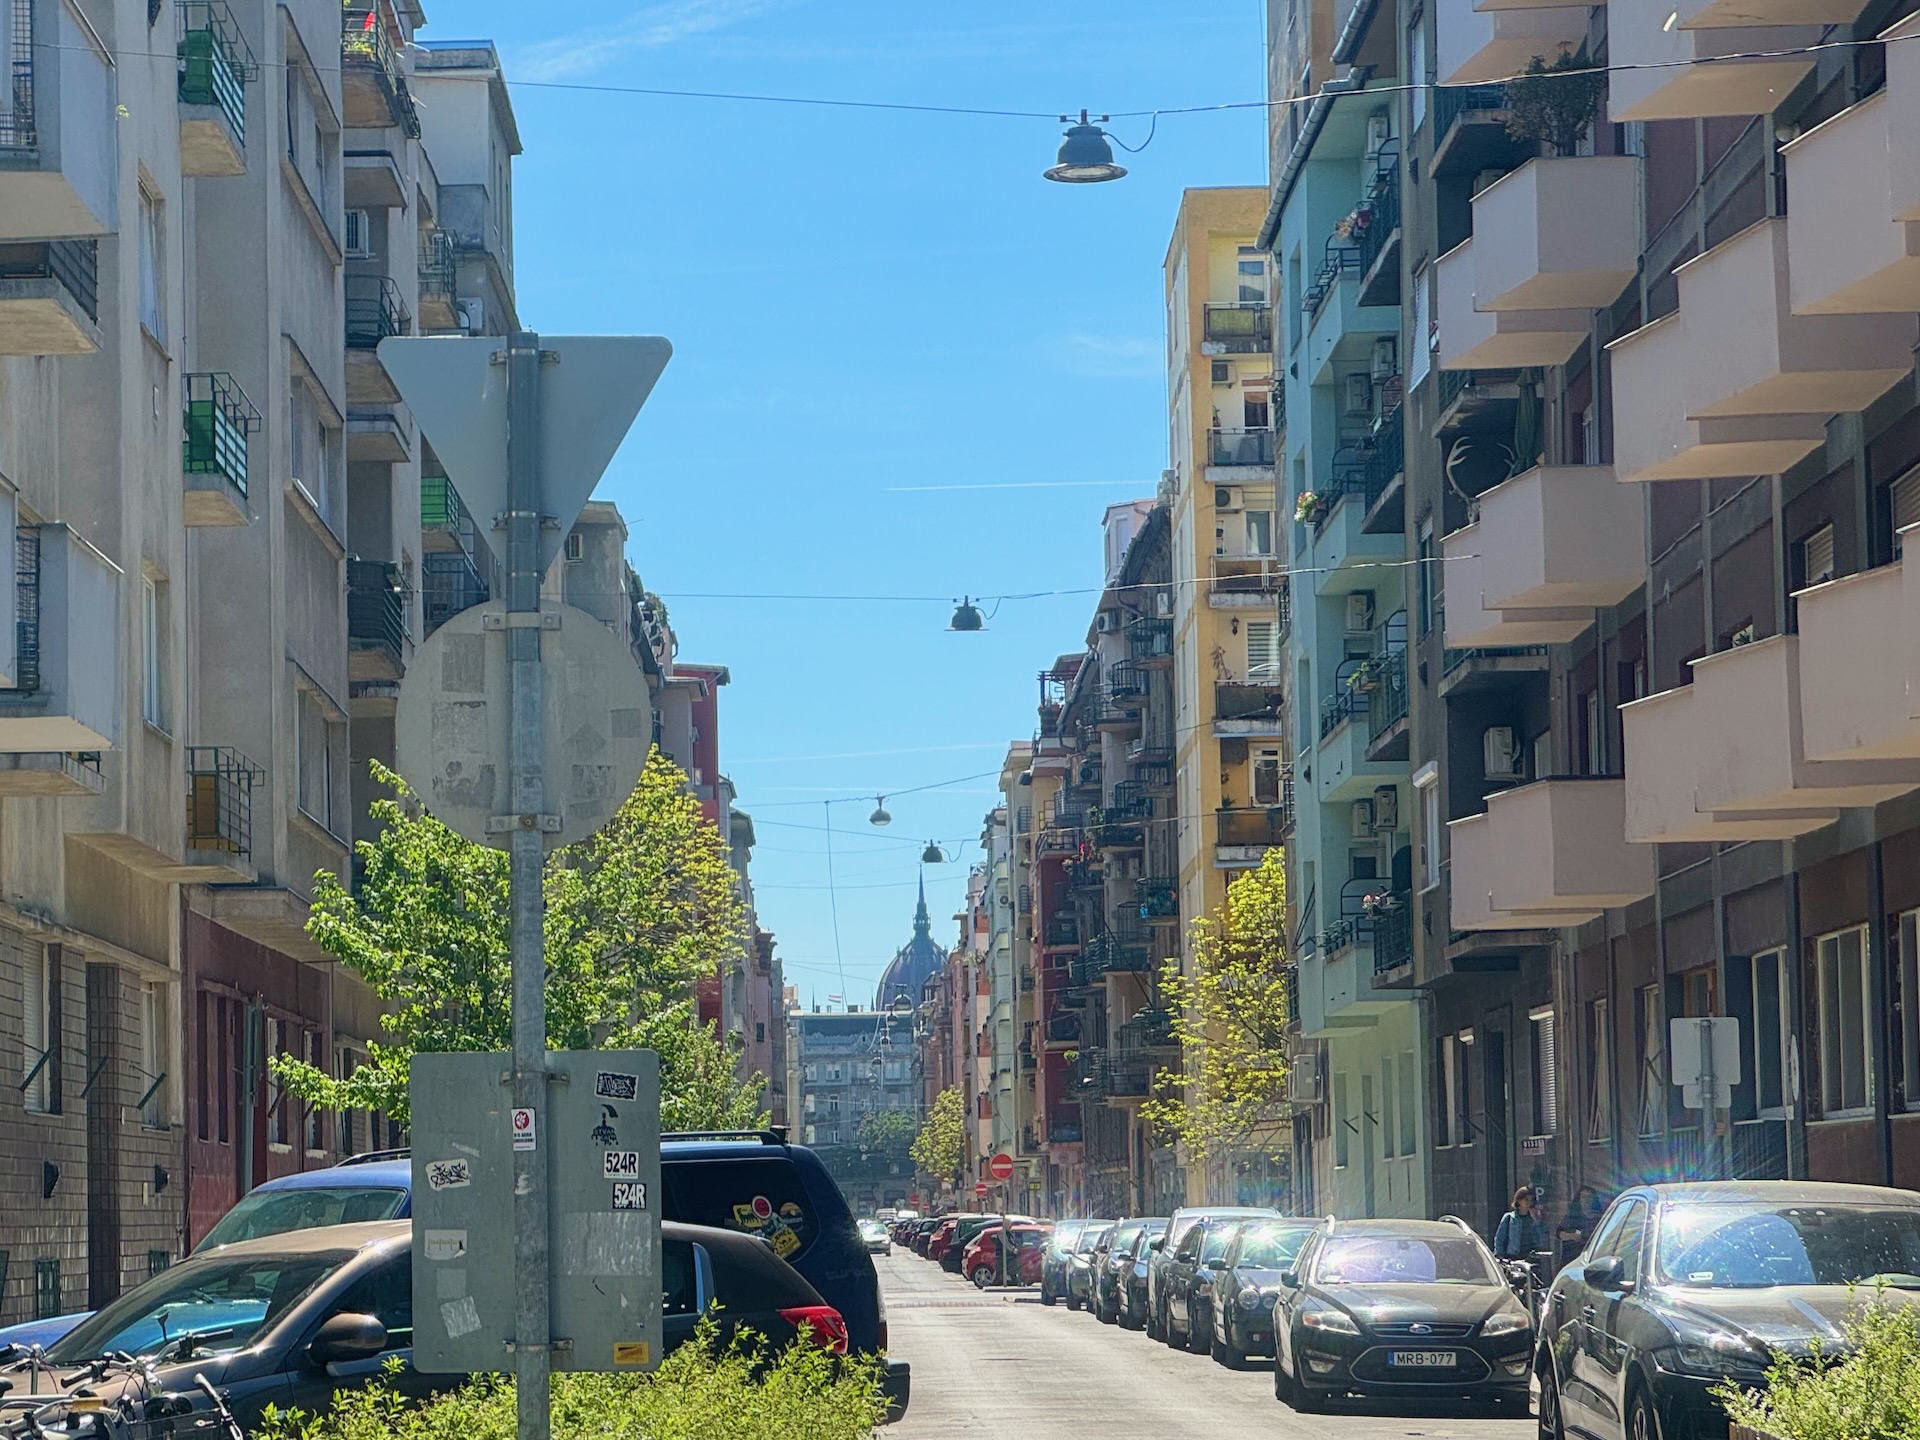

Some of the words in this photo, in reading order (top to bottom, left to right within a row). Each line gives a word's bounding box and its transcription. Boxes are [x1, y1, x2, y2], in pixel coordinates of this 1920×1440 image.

[606, 1152, 636, 1173] 524R
[614, 1183, 645, 1206] 524R
[1396, 1353, 1453, 1365] MRB-077
